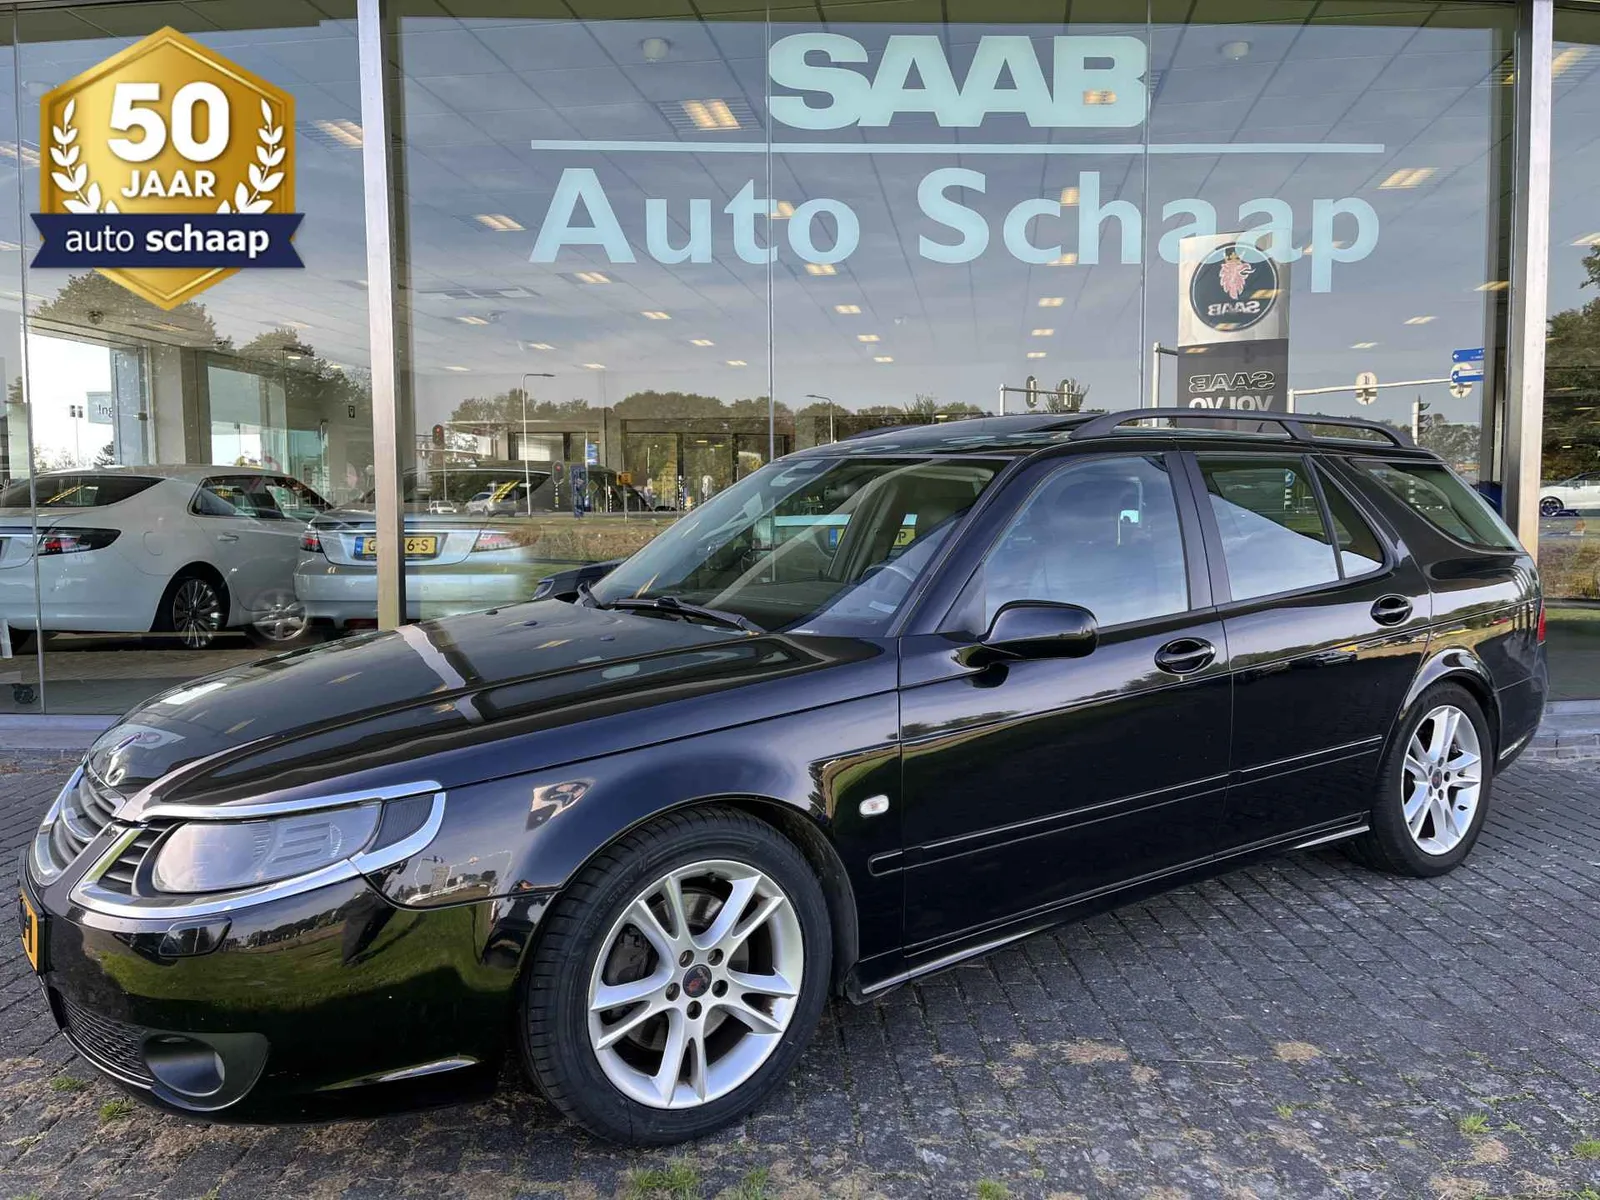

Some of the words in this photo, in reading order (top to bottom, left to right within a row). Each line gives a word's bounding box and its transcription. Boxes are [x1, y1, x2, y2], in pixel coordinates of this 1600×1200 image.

[767, 33, 1149, 130] SAAB
[529, 167, 860, 264] Auto
[917, 167, 1379, 293] Schaap
